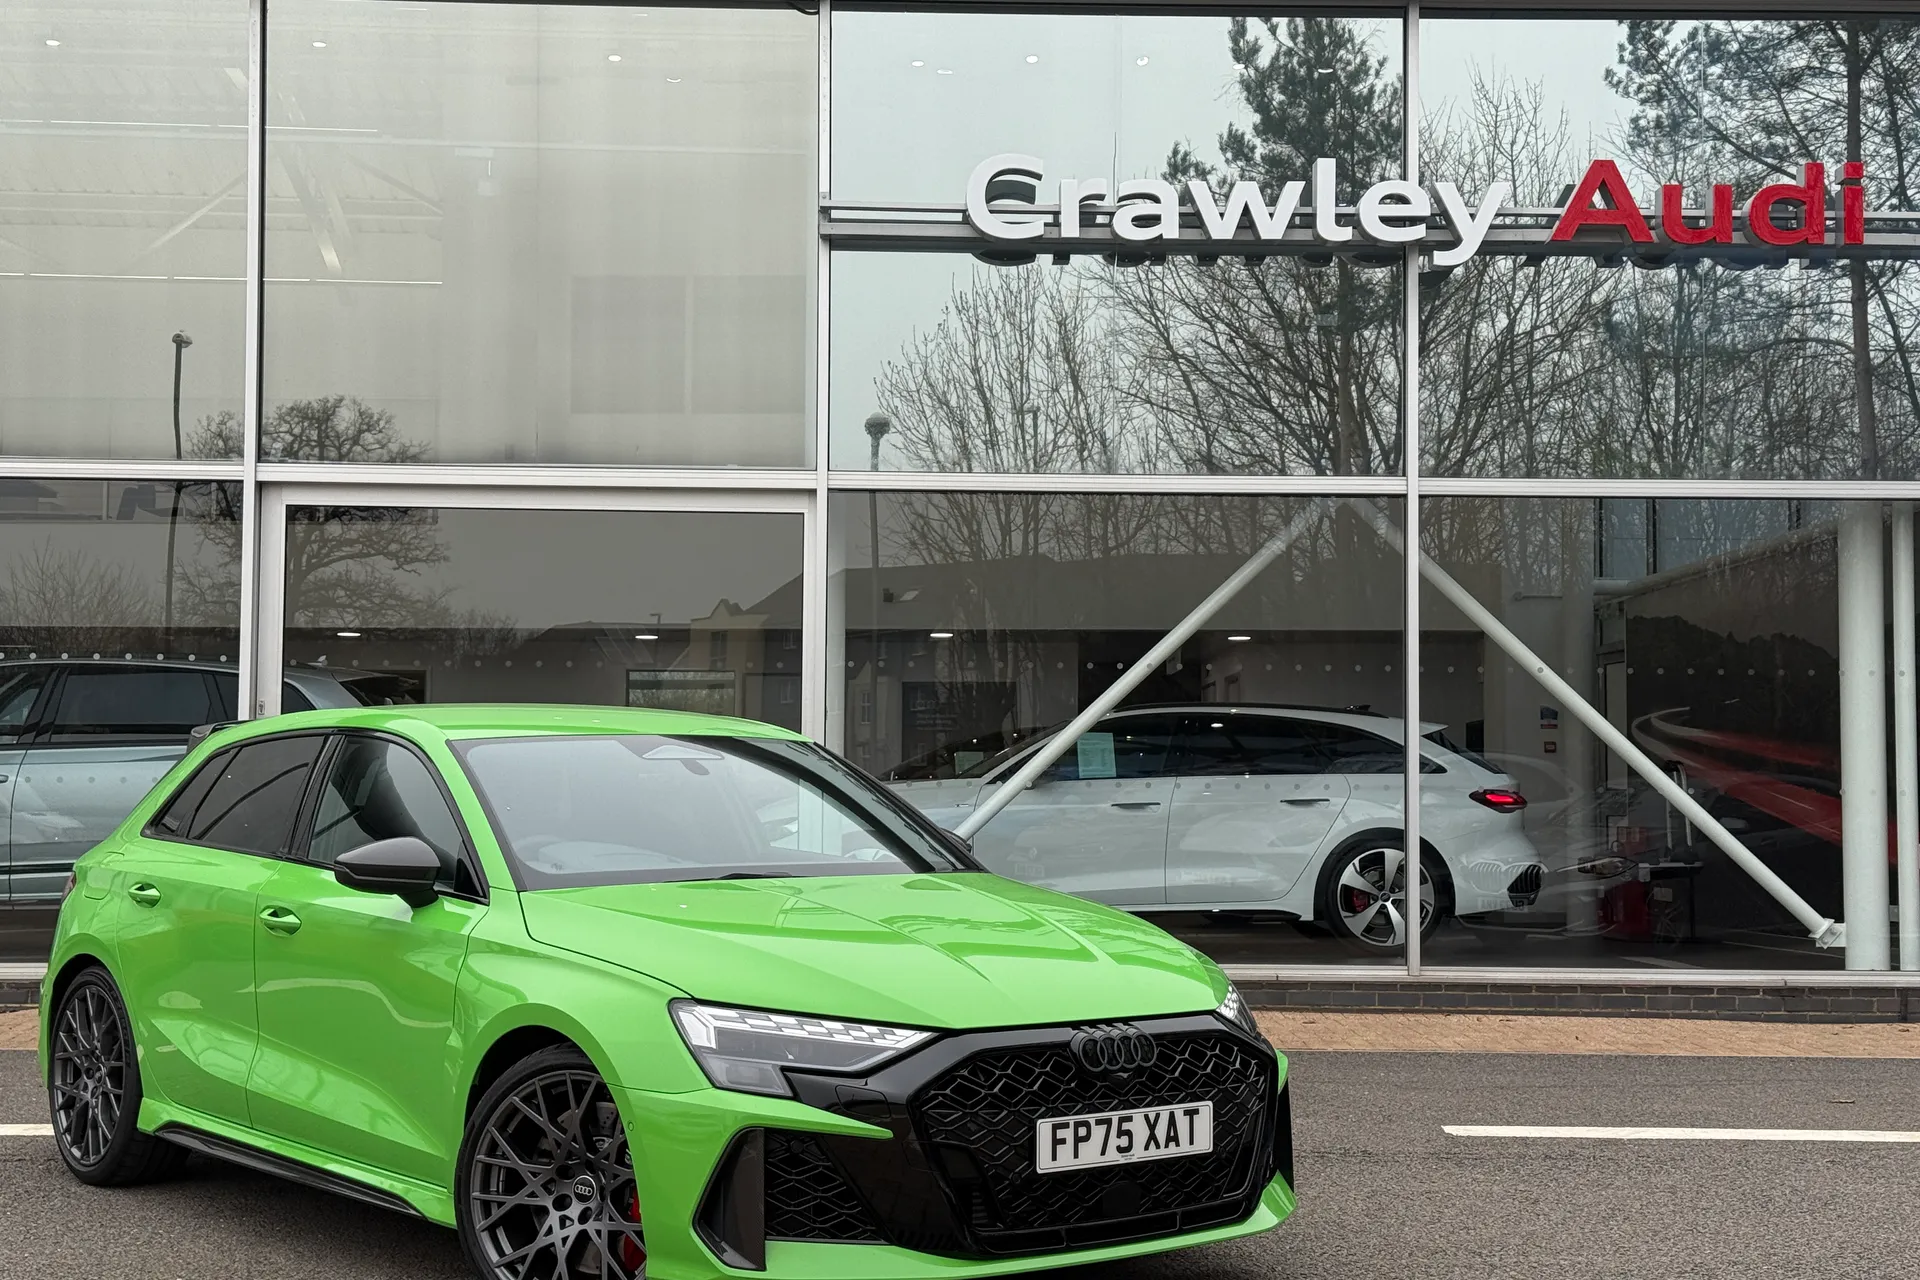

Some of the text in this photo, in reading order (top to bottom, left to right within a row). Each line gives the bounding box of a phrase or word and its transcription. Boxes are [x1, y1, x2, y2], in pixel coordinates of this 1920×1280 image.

[966, 153, 1864, 267] Crawley Audi
[1051, 1108, 1200, 1162] FP75 XAT
